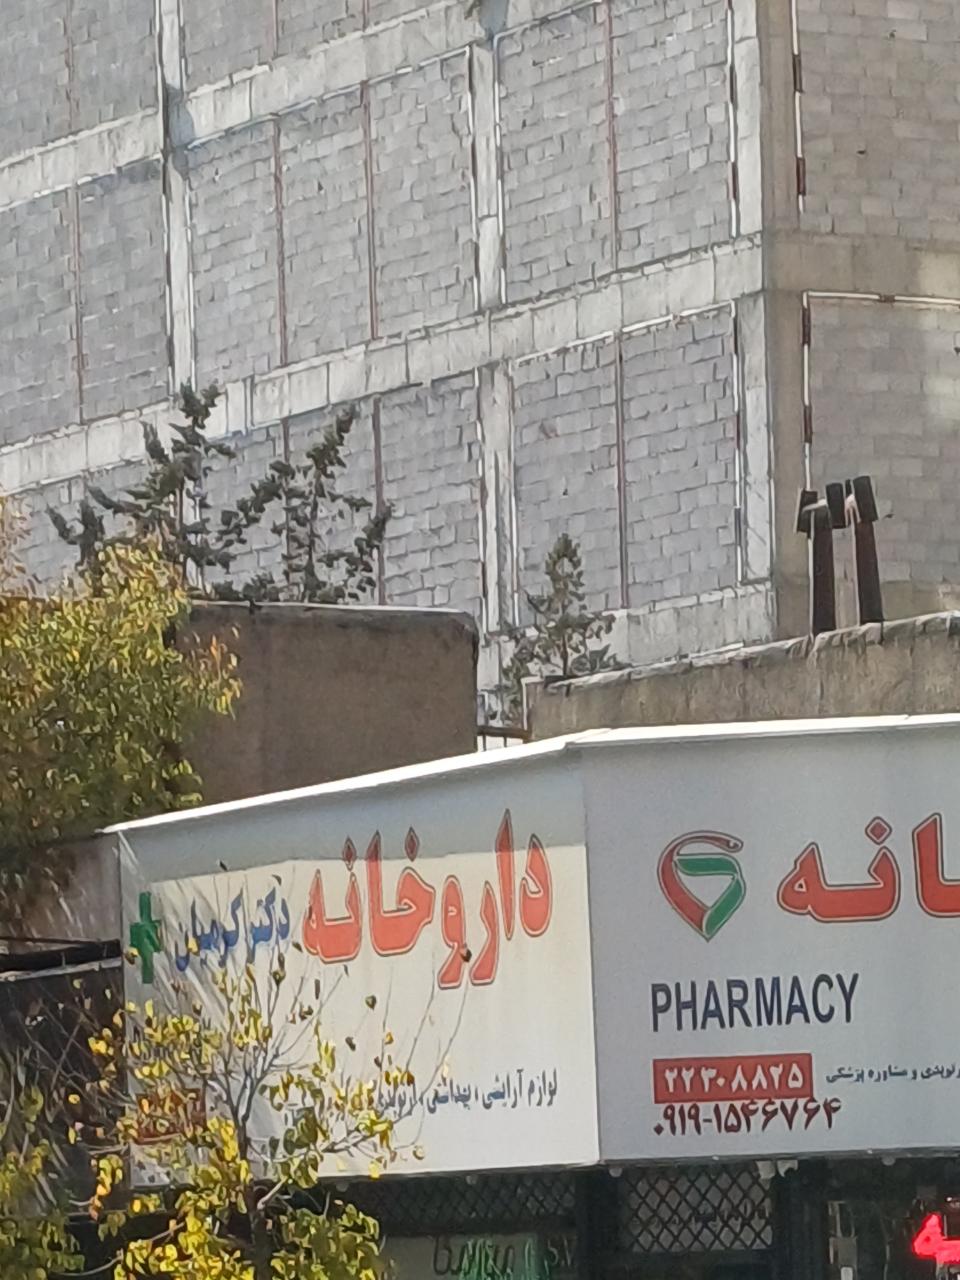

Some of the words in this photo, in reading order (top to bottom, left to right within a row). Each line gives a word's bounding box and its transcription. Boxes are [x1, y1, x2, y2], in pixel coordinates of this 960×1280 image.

[302, 808, 553, 989] داروخانه
[651, 973, 859, 1032] PHARMACY
[528, 1068, 557, 1107] لوازم
[664, 1063, 803, 1093] ۲۲۳۰۸۸۲۵
[911, 1069, 918, 1080] و
[653, 1097, 842, 1136] ۰۹۱۹-۱۵۴۶۷۶۴
